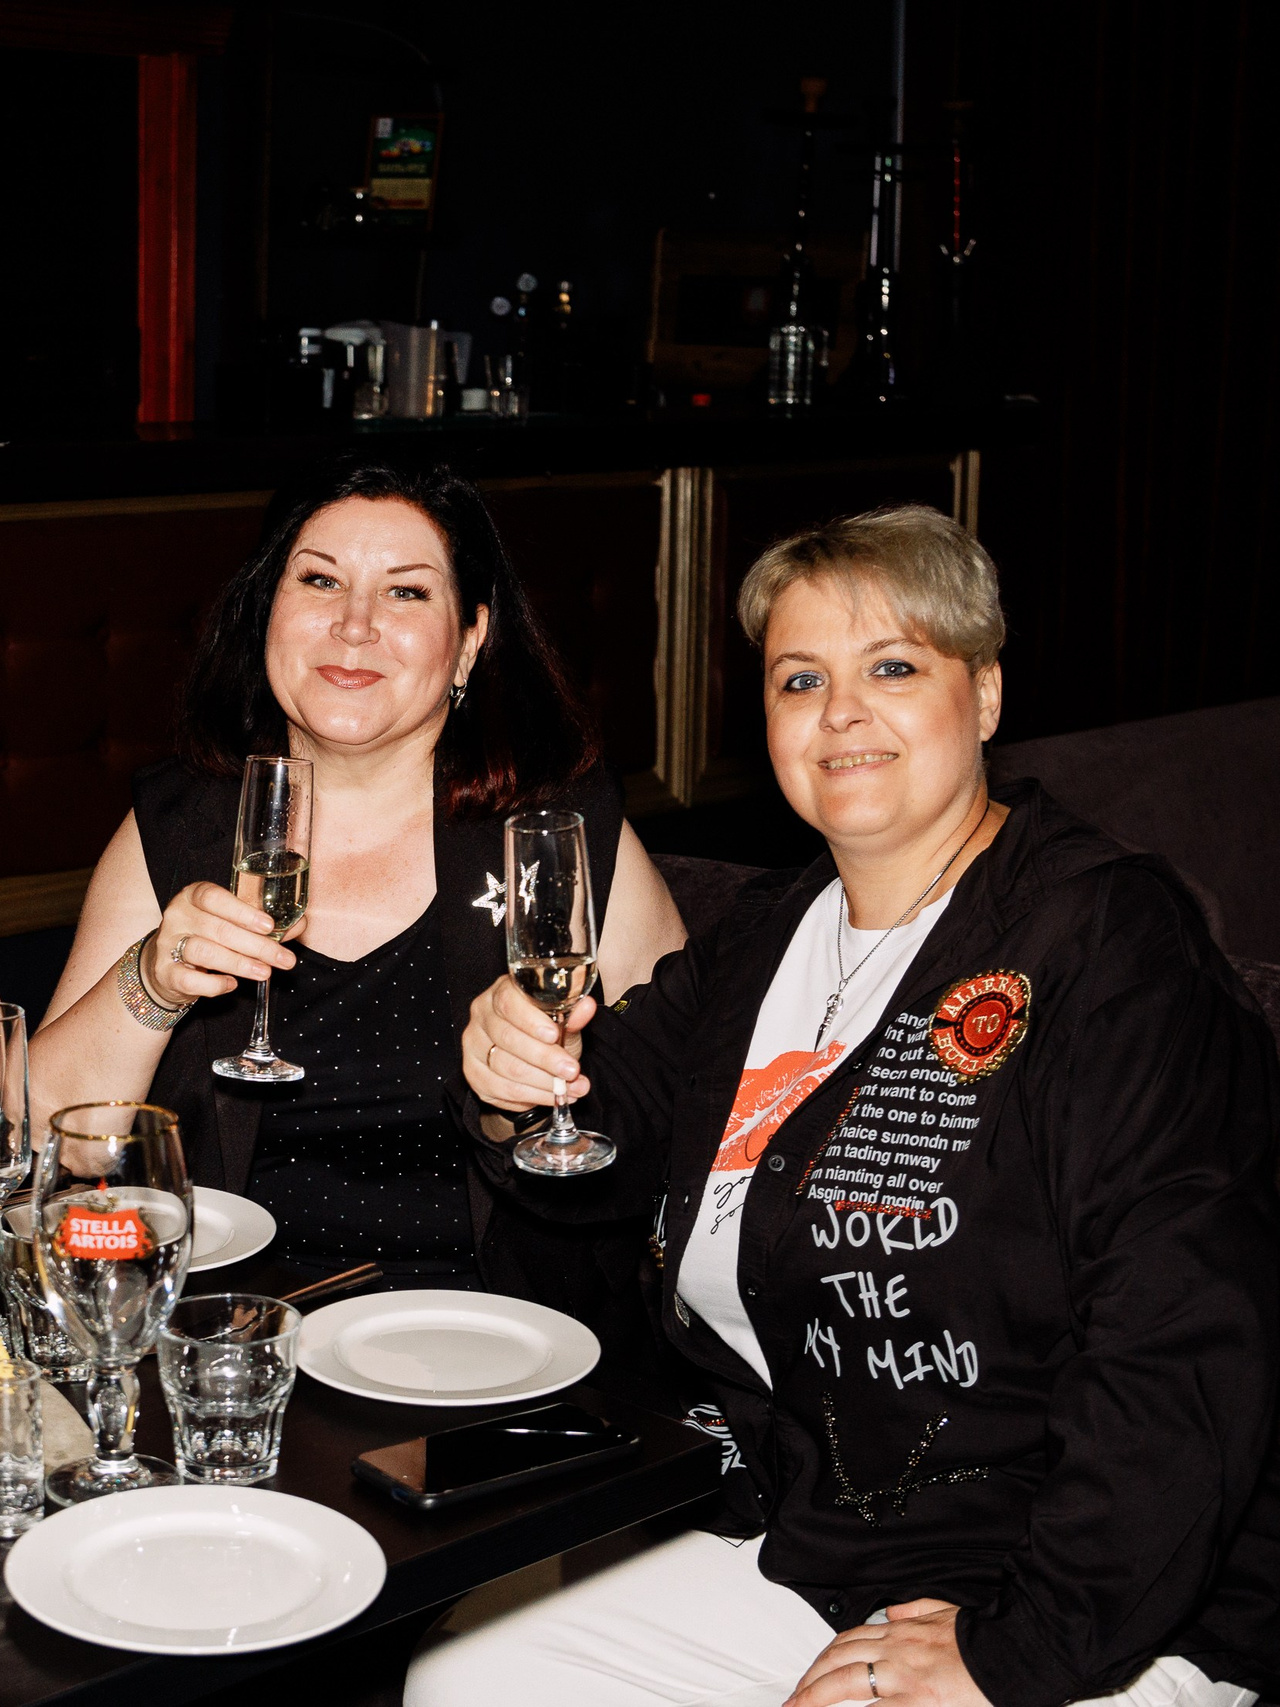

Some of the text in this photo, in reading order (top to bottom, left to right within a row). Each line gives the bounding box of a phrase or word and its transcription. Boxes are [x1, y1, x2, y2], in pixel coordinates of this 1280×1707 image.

[972, 1013, 1000, 1034] TO
[899, 1046, 925, 1062] out
[880, 1085, 917, 1100] want
[919, 1087, 935, 1102] to
[938, 1091, 977, 1106] come
[861, 1103, 884, 1119] the
[887, 1108, 918, 1124] one
[920, 1110, 936, 1125] to
[844, 1143, 891, 1166] tading
[894, 1152, 941, 1174] mway
[885, 1173, 907, 1189] all
[908, 1178, 944, 1194] over
[69, 1217, 138, 1235] STELLA
[69, 1233, 138, 1250] ARTOIS
[821, 1271, 910, 1319] THE
[867, 1329, 979, 1390] MIND
